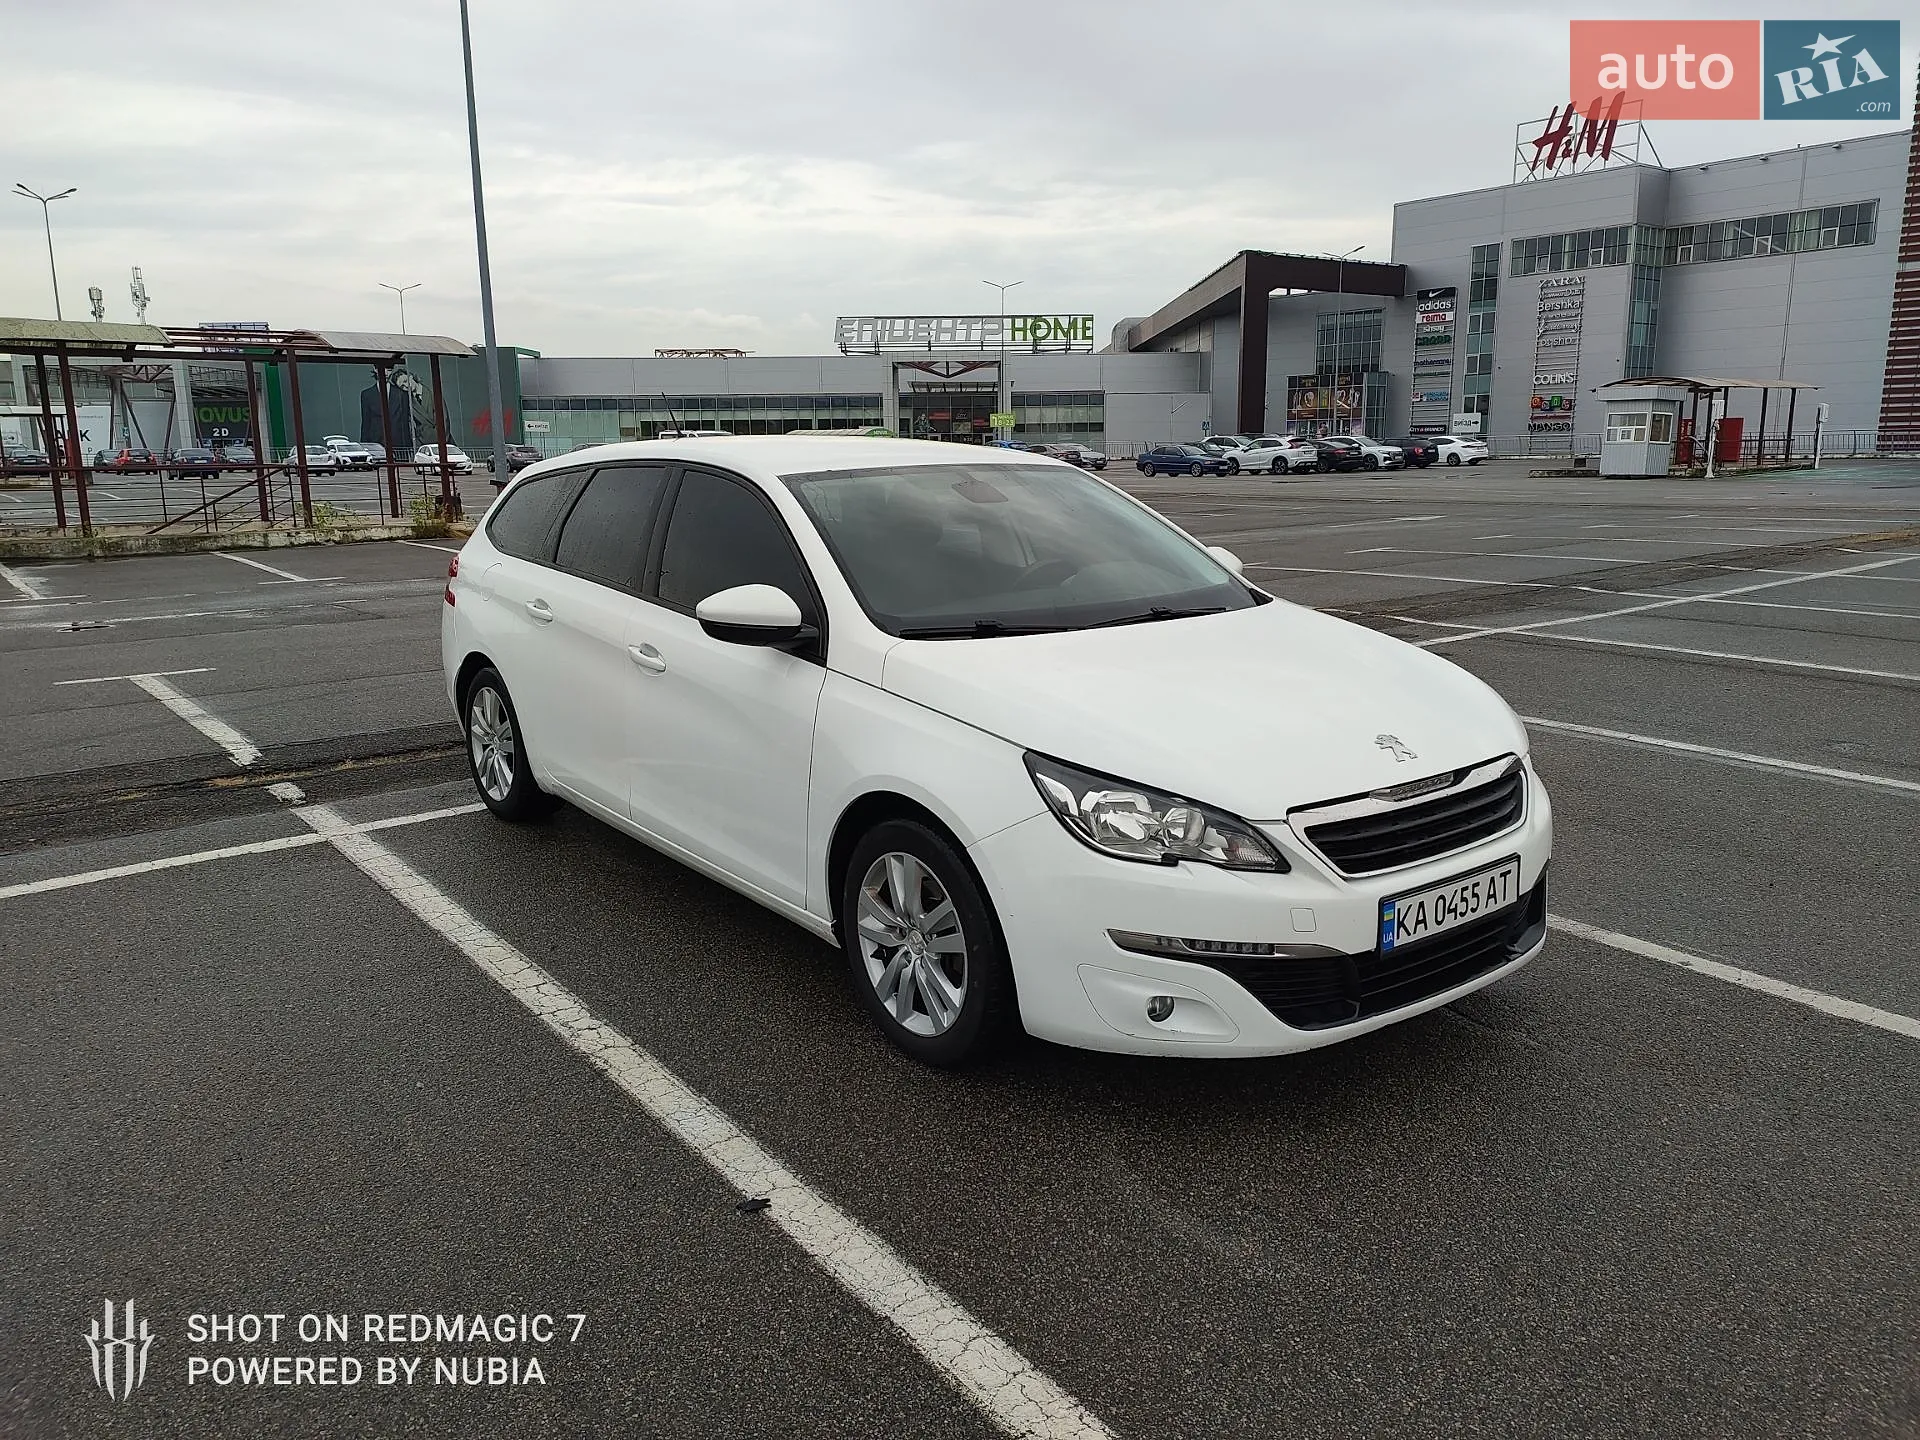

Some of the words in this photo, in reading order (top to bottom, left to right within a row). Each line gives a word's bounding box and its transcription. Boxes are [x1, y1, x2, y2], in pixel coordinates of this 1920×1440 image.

[1532, 91, 1627, 171] H&M
[1537, 276, 1582, 288] ZARA
[1418, 300, 1452, 312] adidas
[1537, 299, 1580, 312] Bershka
[1421, 313, 1447, 322] reima
[834, 319, 1003, 342] ЕПІЦЕНТР
[1010, 316, 1093, 342] HOME
[1533, 372, 1574, 385] COLIN'S
[194, 407, 251, 422] OVUS
[1527, 422, 1572, 433] MANGO
[1395, 900, 1428, 940] KA
[1434, 881, 1481, 926] 0455
[1484, 869, 1512, 909] AT
[1383, 931, 1394, 943] UA
